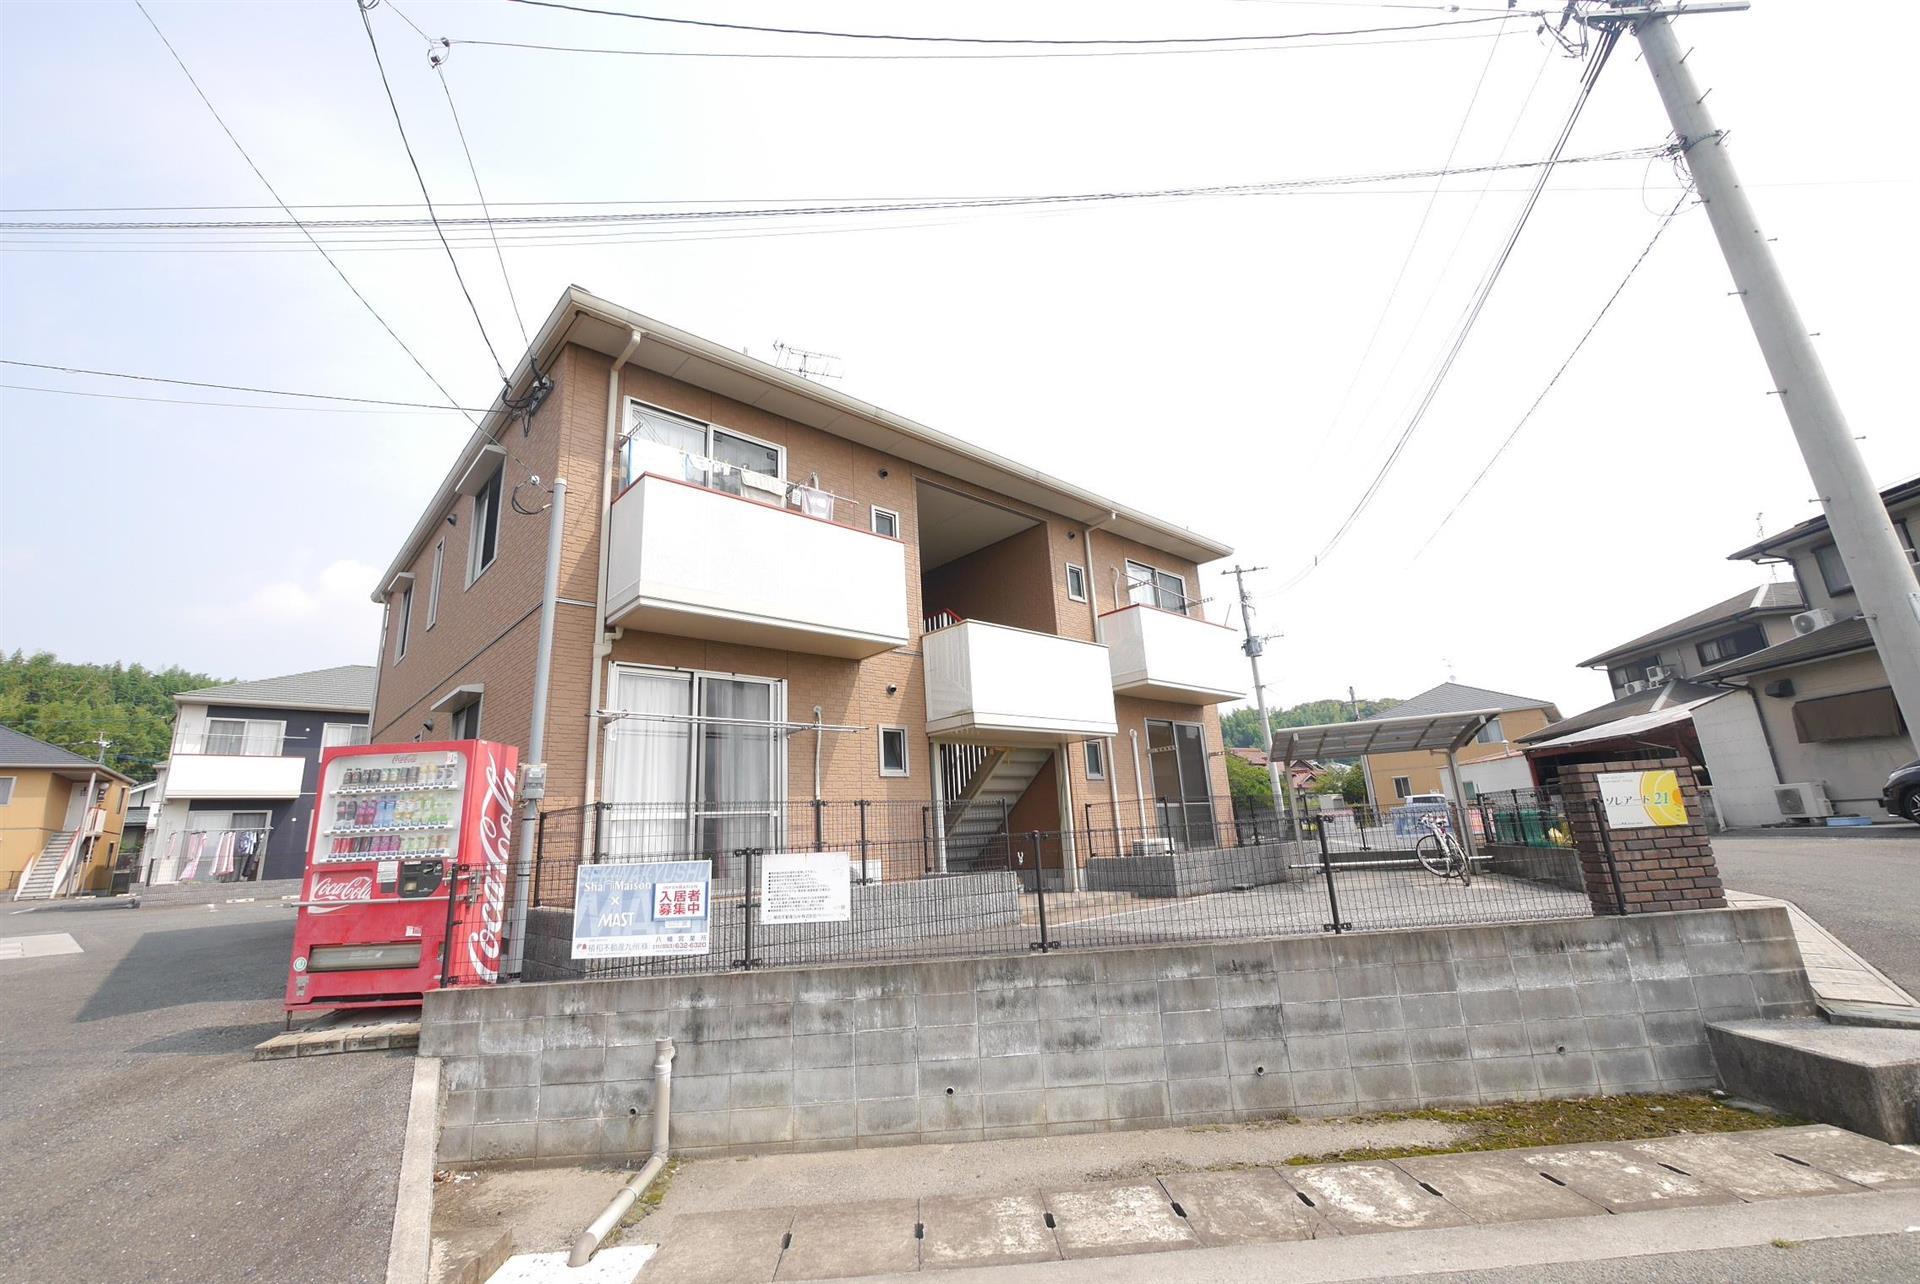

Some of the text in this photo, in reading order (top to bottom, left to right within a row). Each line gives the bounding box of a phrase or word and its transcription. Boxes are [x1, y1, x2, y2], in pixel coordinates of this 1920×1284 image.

[313, 876, 373, 900] Coca-Cola
[614, 880, 652, 892] Maison
[659, 889, 701, 903] 入居者
[659, 902, 701, 916] 募集中
[597, 912, 636, 928] MAST
